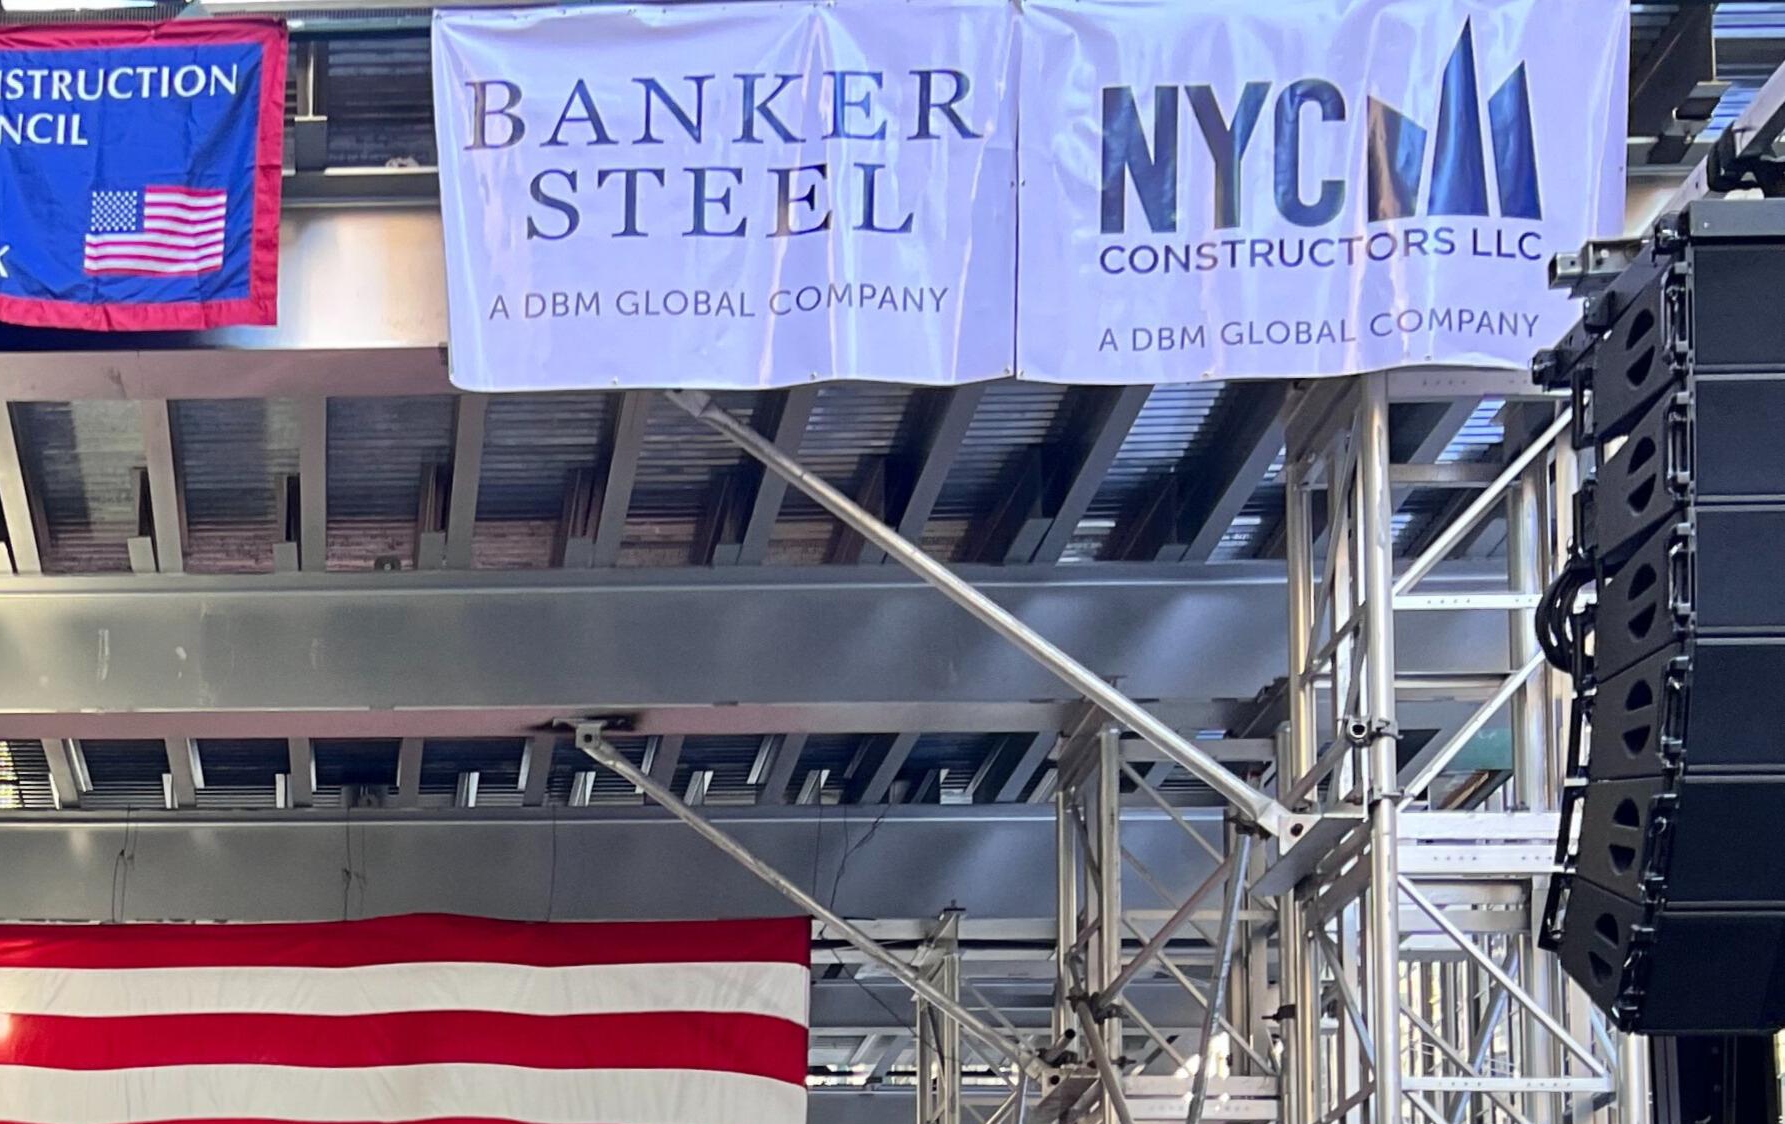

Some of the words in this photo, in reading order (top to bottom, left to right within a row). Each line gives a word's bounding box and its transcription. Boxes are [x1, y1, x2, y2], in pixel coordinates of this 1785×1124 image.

[463, 68, 984, 151] BANKER
[1099, 78, 1347, 235] NYC
[526, 162, 915, 241] STEEL
[1099, 227, 1456, 275] CONSTRUCTORS
[1472, 229, 1543, 262] LLC
[489, 294, 511, 321] A
[524, 291, 601, 319] DBM
[616, 289, 756, 318] GLOBAL
[769, 283, 950, 315] COMPANY
[1098, 328, 1119, 352] A
[1131, 324, 1206, 352] DBM
[1220, 318, 1355, 346] GLOBAL
[1369, 308, 1540, 338] COMPANY
